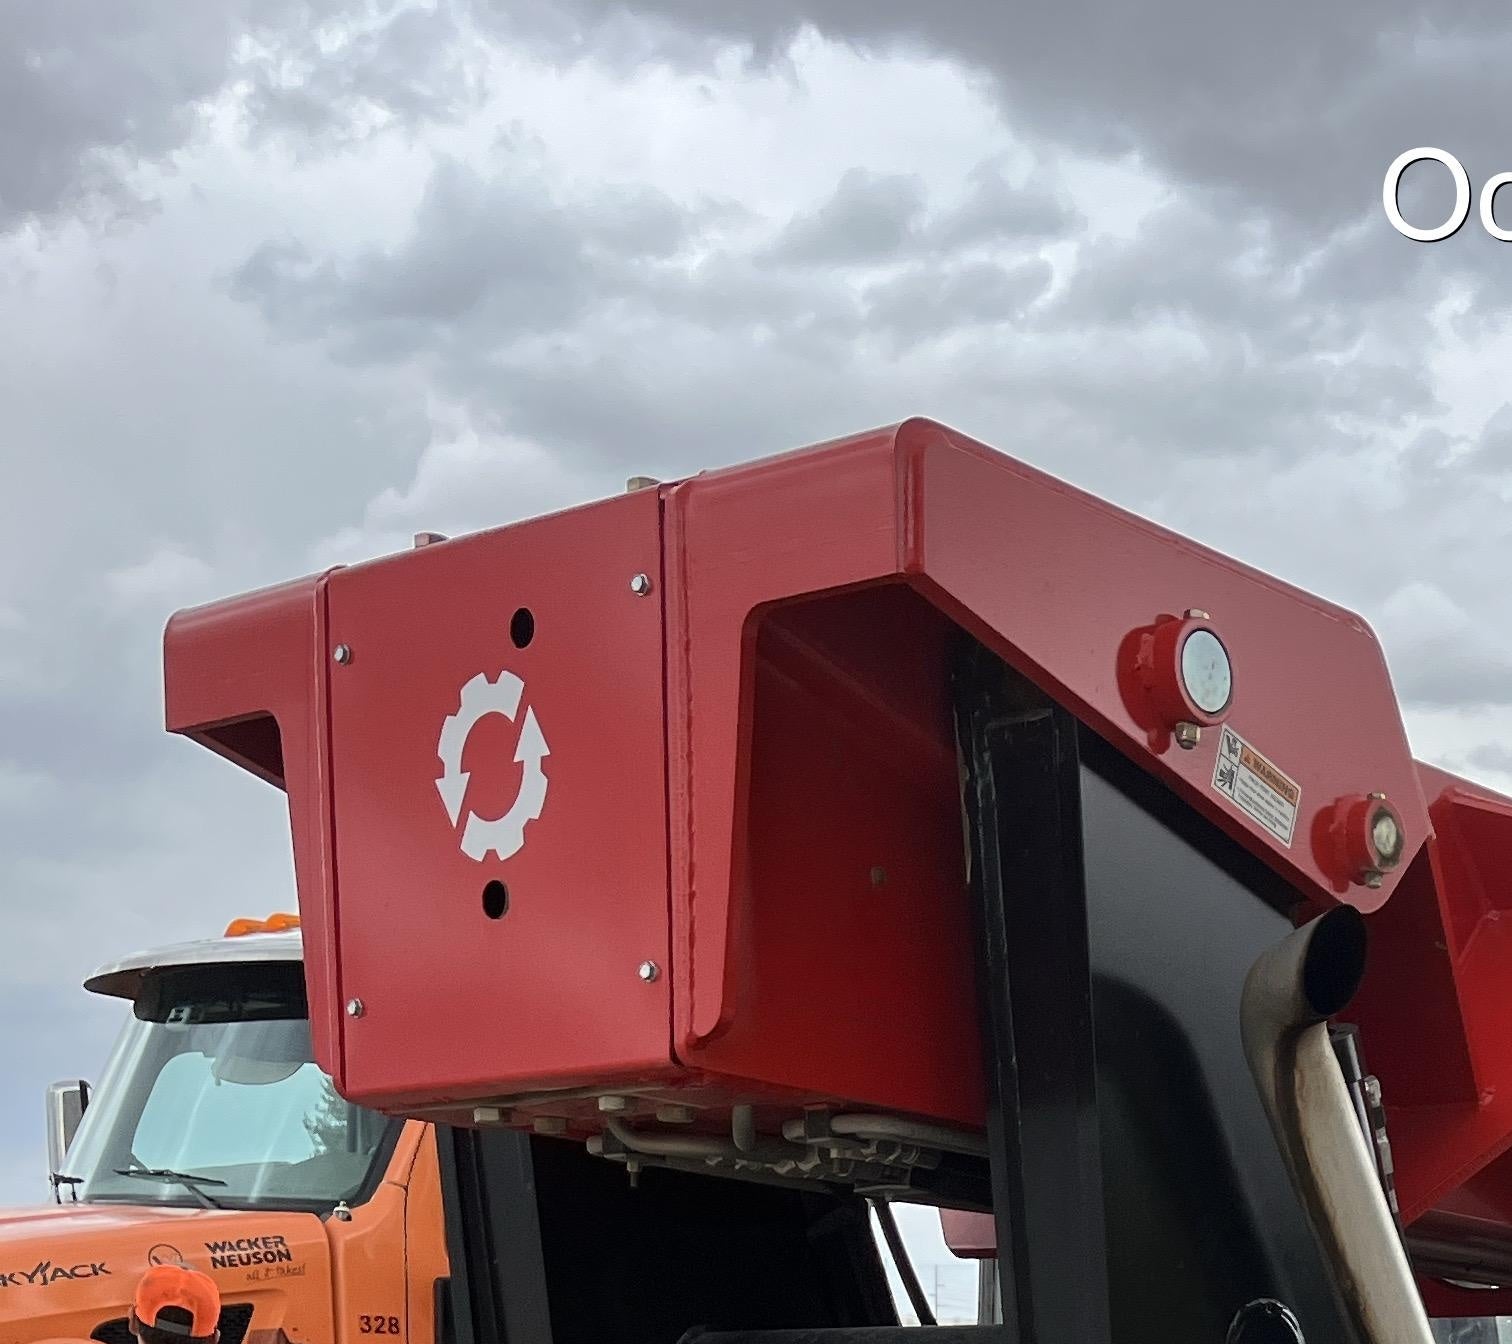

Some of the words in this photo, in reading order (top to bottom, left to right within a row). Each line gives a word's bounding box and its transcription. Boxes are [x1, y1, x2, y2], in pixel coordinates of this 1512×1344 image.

[204, 1235, 287, 1255] WACKER
[211, 1249, 293, 1269] NEUSON
[0, 1260, 111, 1287] KYJACK
[360, 1315, 400, 1335] 328
